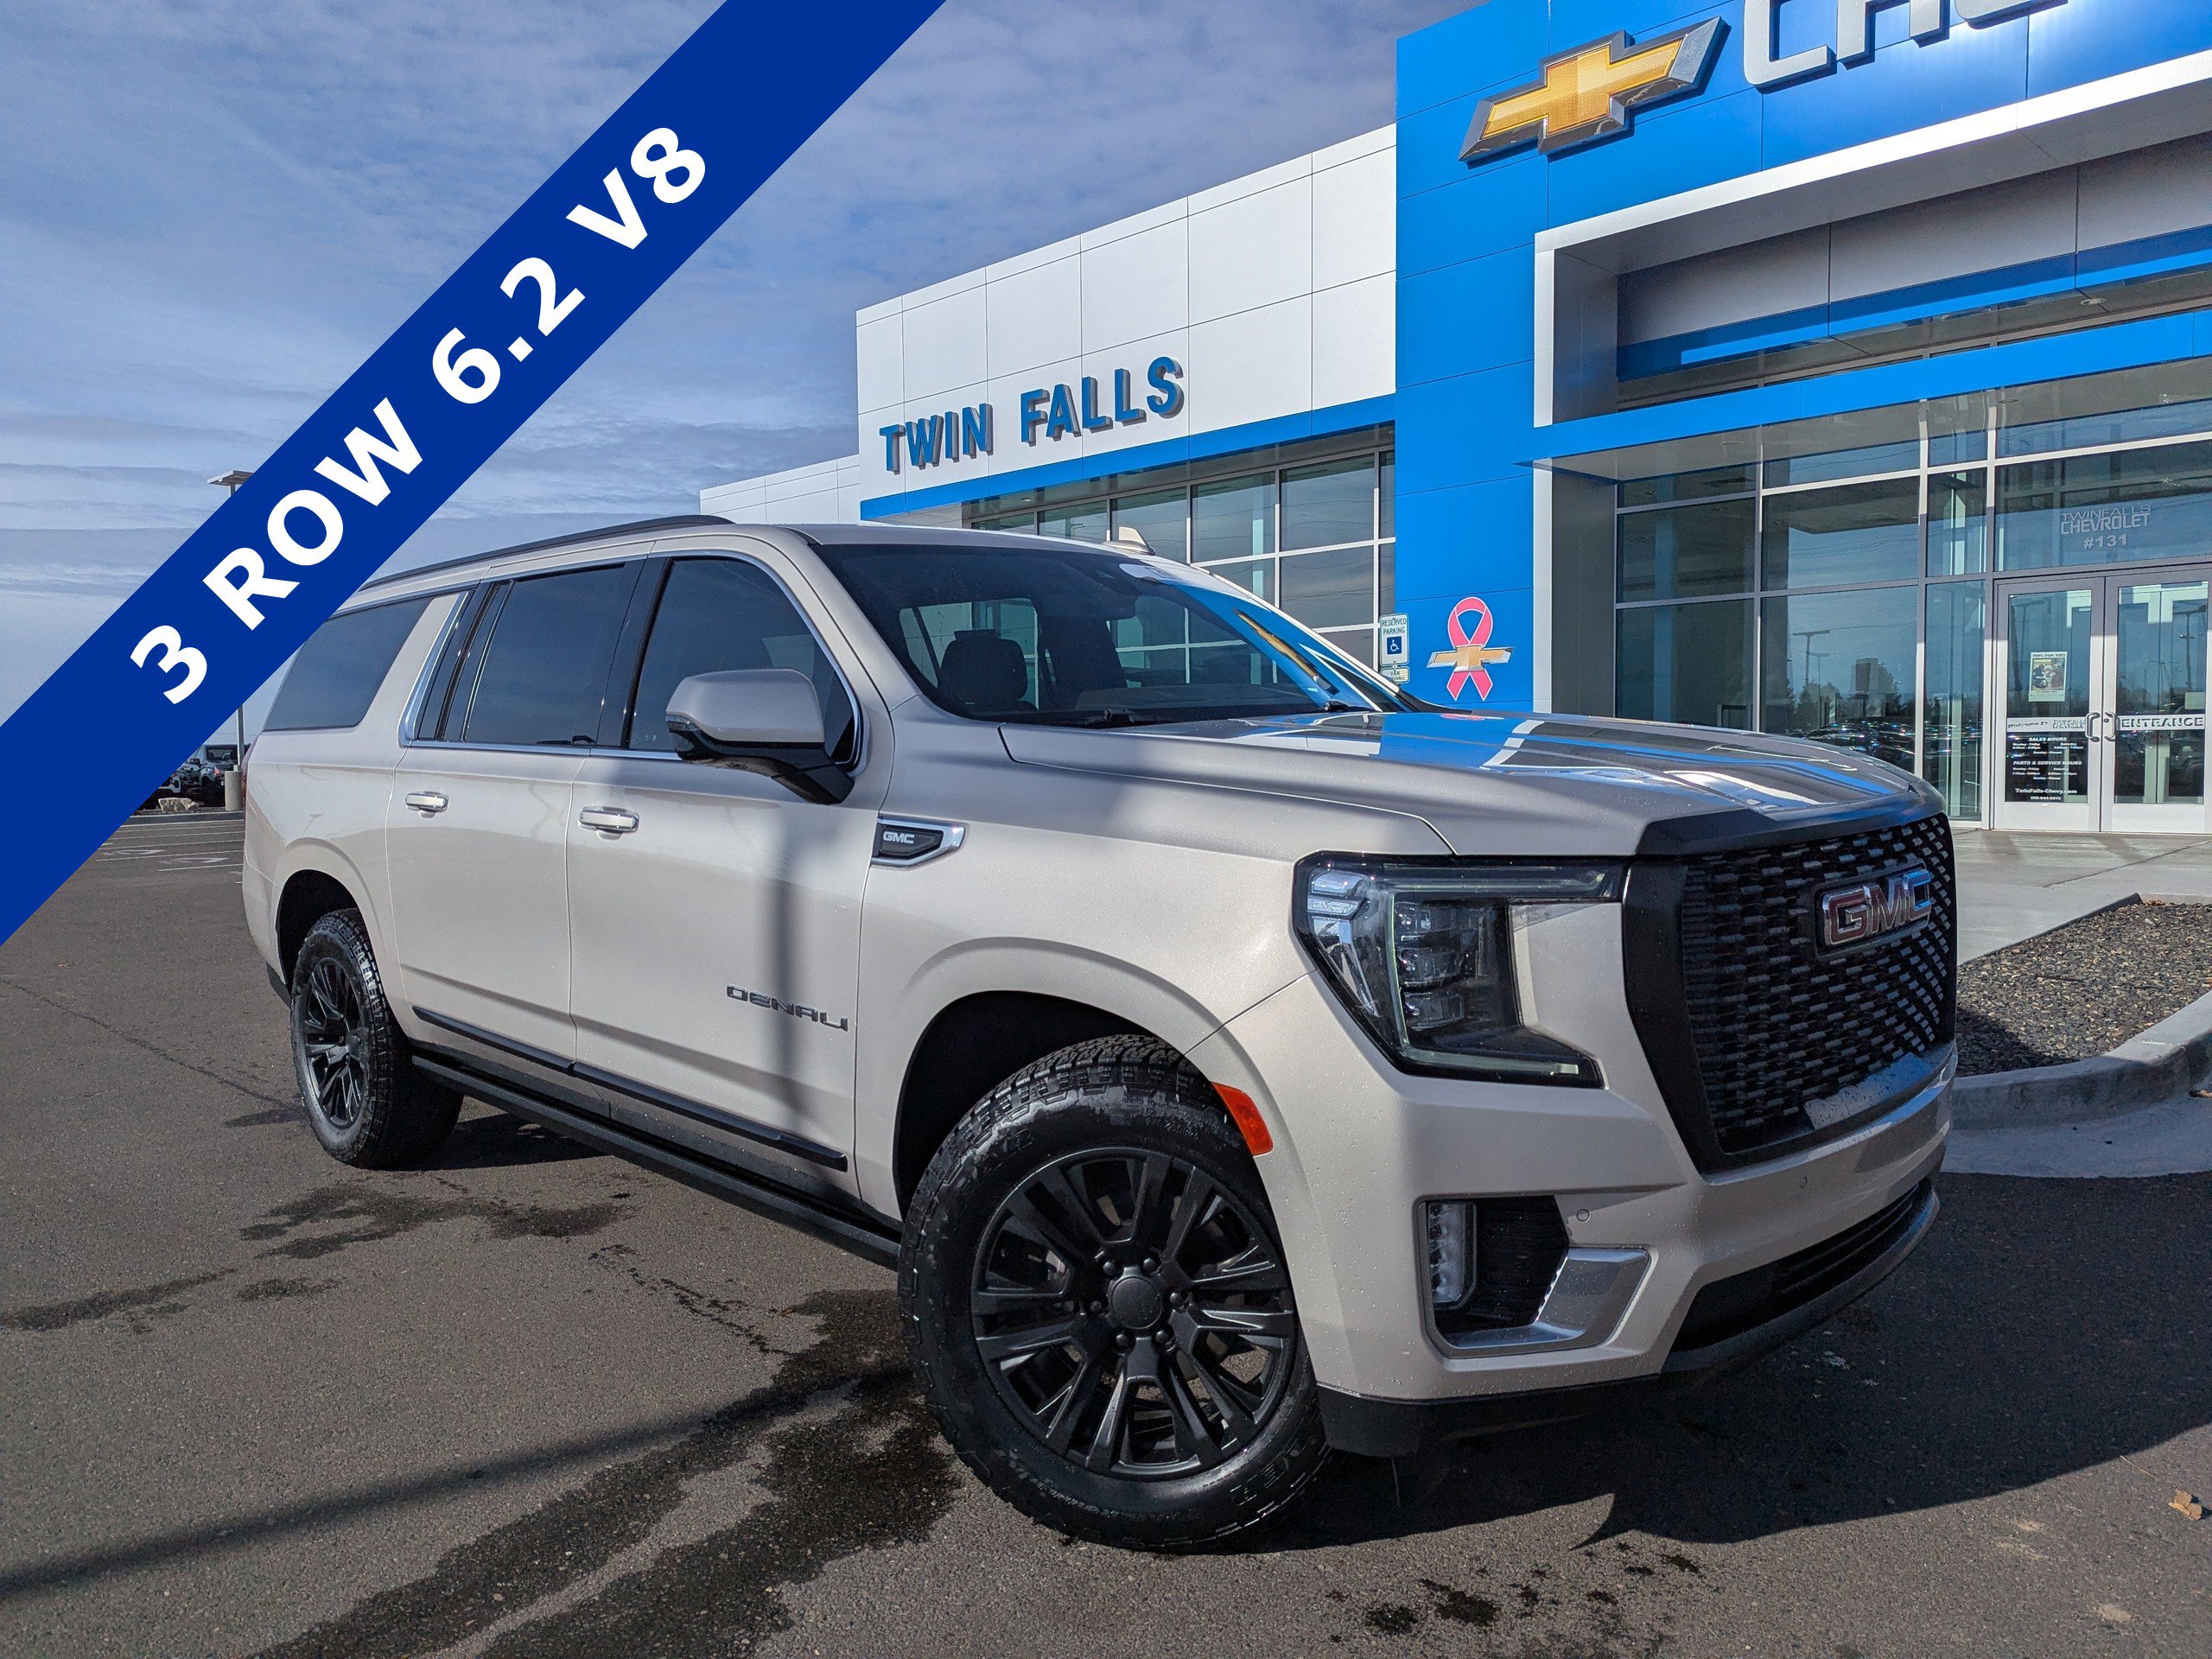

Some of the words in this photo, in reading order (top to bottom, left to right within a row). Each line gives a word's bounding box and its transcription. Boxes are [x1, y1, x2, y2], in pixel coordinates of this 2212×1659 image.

[880, 404, 994, 475] TWIN
[1020, 356, 1185, 447] FALLS
[2061, 512, 2151, 534] CHEVROLET
[2083, 533, 2126, 549] #131
[1382, 618, 1407, 626] RESERVED
[1383, 626, 1406, 635] PARKING
[2121, 717, 2204, 728] ENTRANCE
[883, 831, 915, 844] GMC
[1822, 868, 1932, 945] GMC
[726, 983, 849, 1032] DENALI
